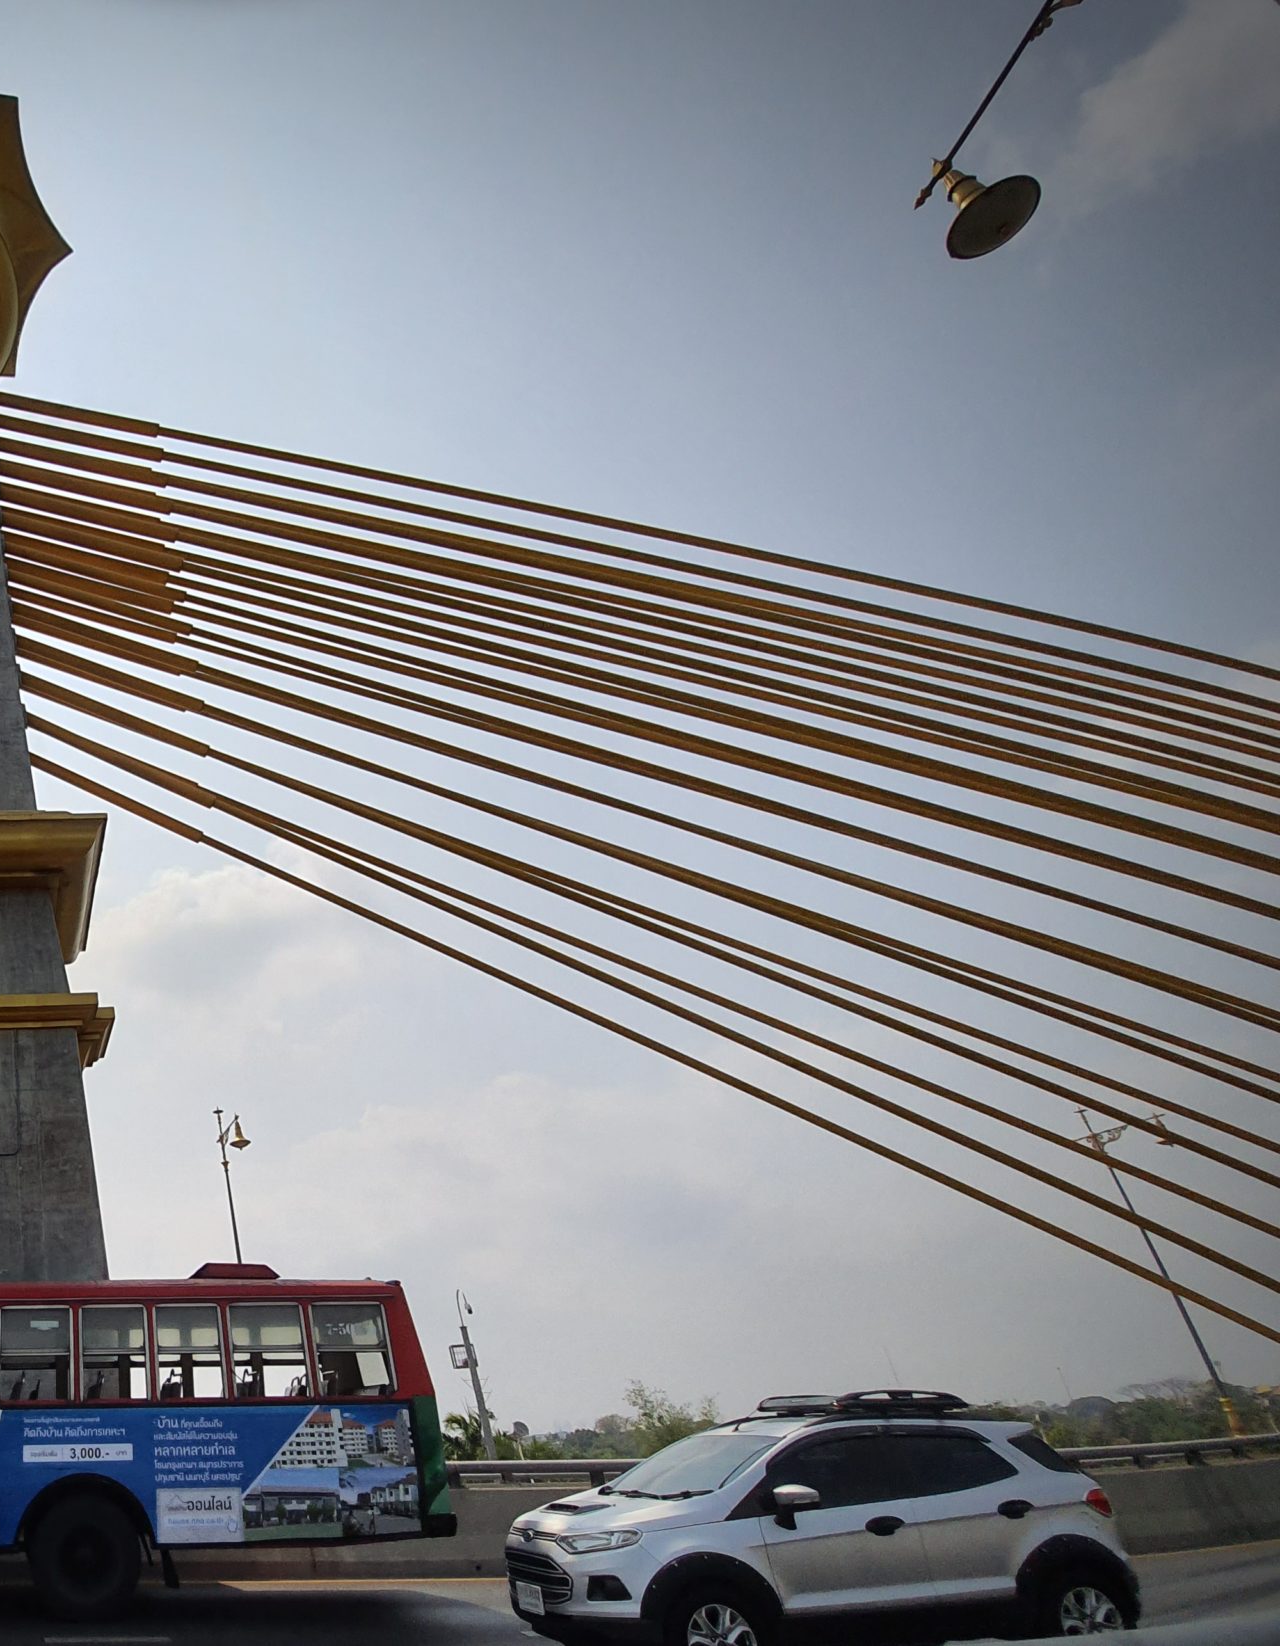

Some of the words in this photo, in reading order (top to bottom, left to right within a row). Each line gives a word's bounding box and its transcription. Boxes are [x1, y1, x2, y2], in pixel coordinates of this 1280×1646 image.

[23, 1425, 63, 1438] คิดถึงบ้าน
[154, 1442, 236, 1457] หลากหลายทำเล
